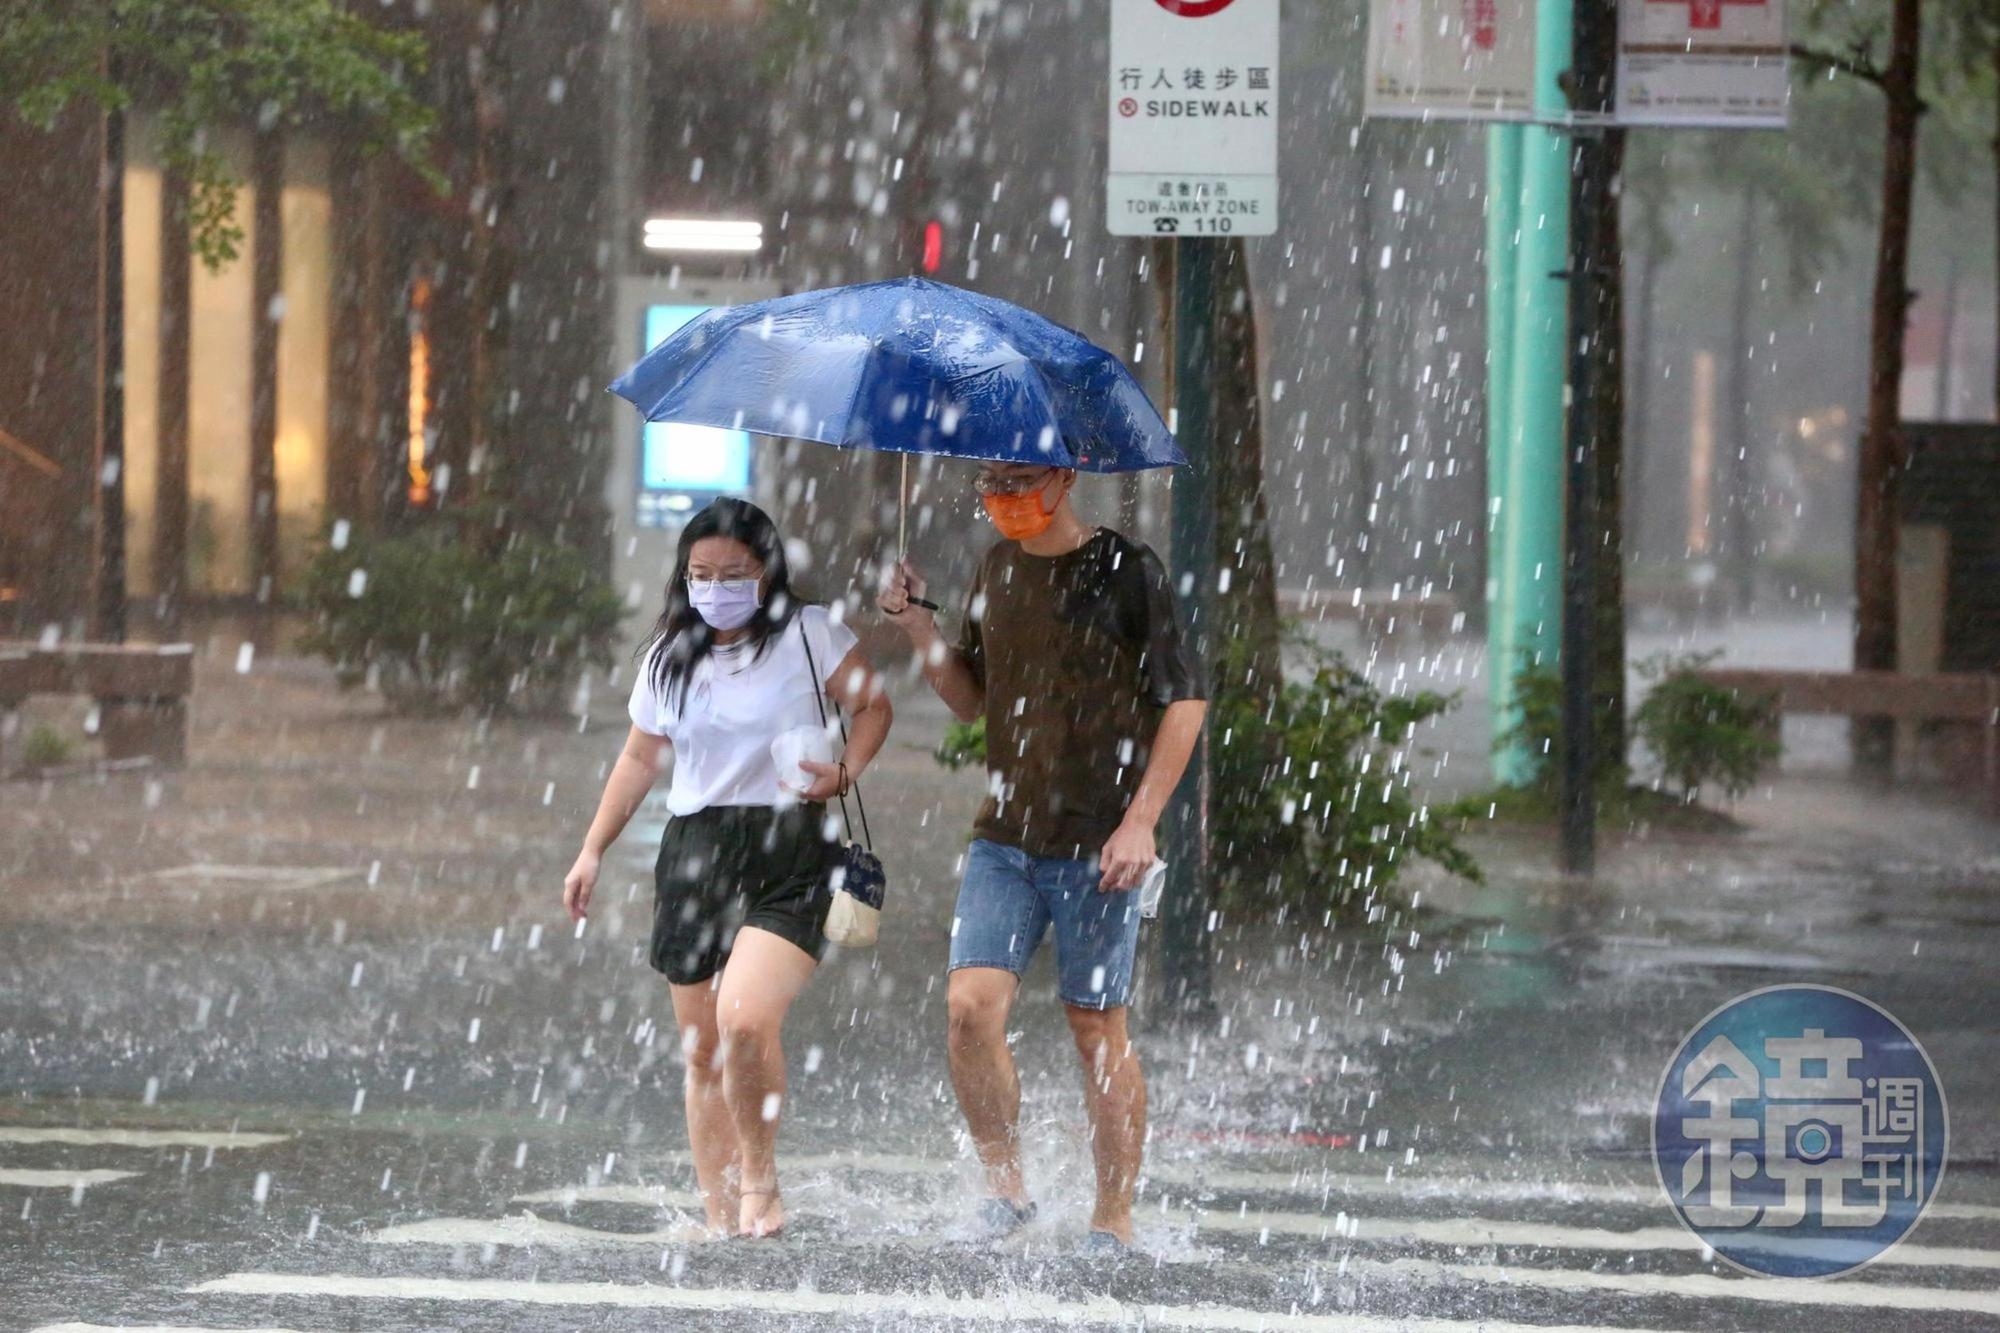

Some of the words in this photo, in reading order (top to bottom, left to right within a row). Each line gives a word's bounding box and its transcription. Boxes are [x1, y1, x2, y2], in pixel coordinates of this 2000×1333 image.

[1119, 67, 1270, 91] 行人徒步區
[1146, 100, 1269, 118] SIDEWALK
[1126, 199, 1210, 214] TOW-AWAY
[1216, 199, 1260, 214] ZONE
[1194, 217, 1232, 233] 110
